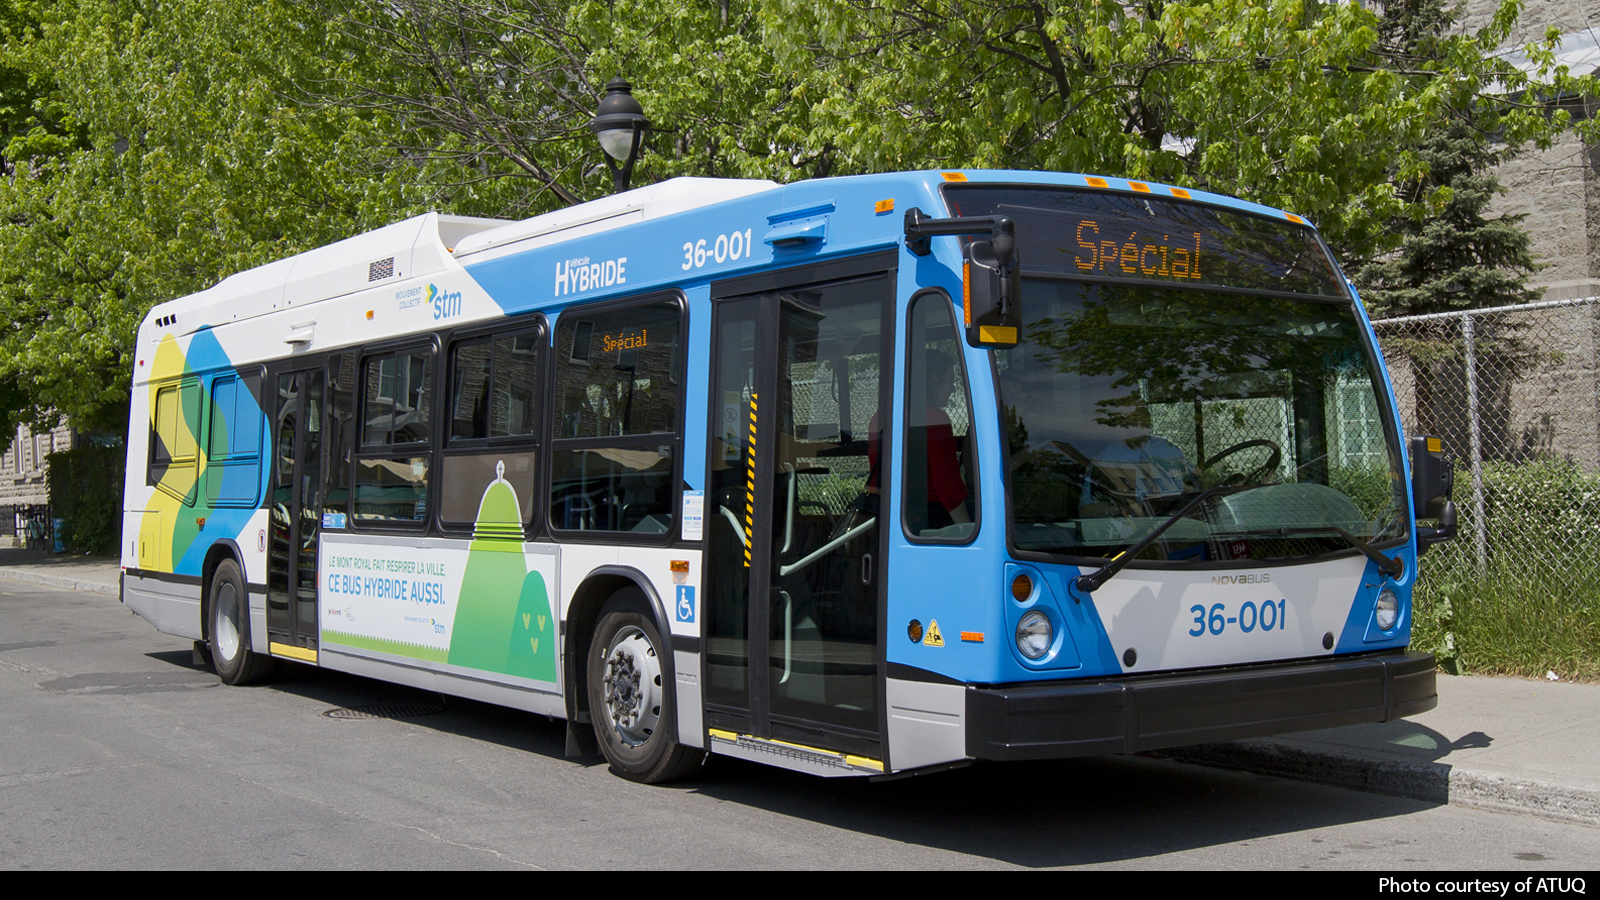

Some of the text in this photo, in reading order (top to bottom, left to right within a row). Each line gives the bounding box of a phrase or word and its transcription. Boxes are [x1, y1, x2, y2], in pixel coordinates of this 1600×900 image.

[569, 255, 591, 268] Véhicule
[681, 227, 752, 271] 36-001
[1075, 219, 1201, 279] Spécial
[554, 256, 628, 297] HYBRIDE
[395, 286, 422, 300] MOUVEMENT
[398, 297, 421, 310] COLLECTIF
[433, 289, 462, 320] stm
[603, 329, 647, 352] Spécial
[328, 555, 446, 578] LE MONT ROYAL FAIT RESPIRER LA VILLE,
[328, 573, 446, 606] CE BUS HYBRIDE AUSSI.
[1188, 598, 1286, 637] 36-001
